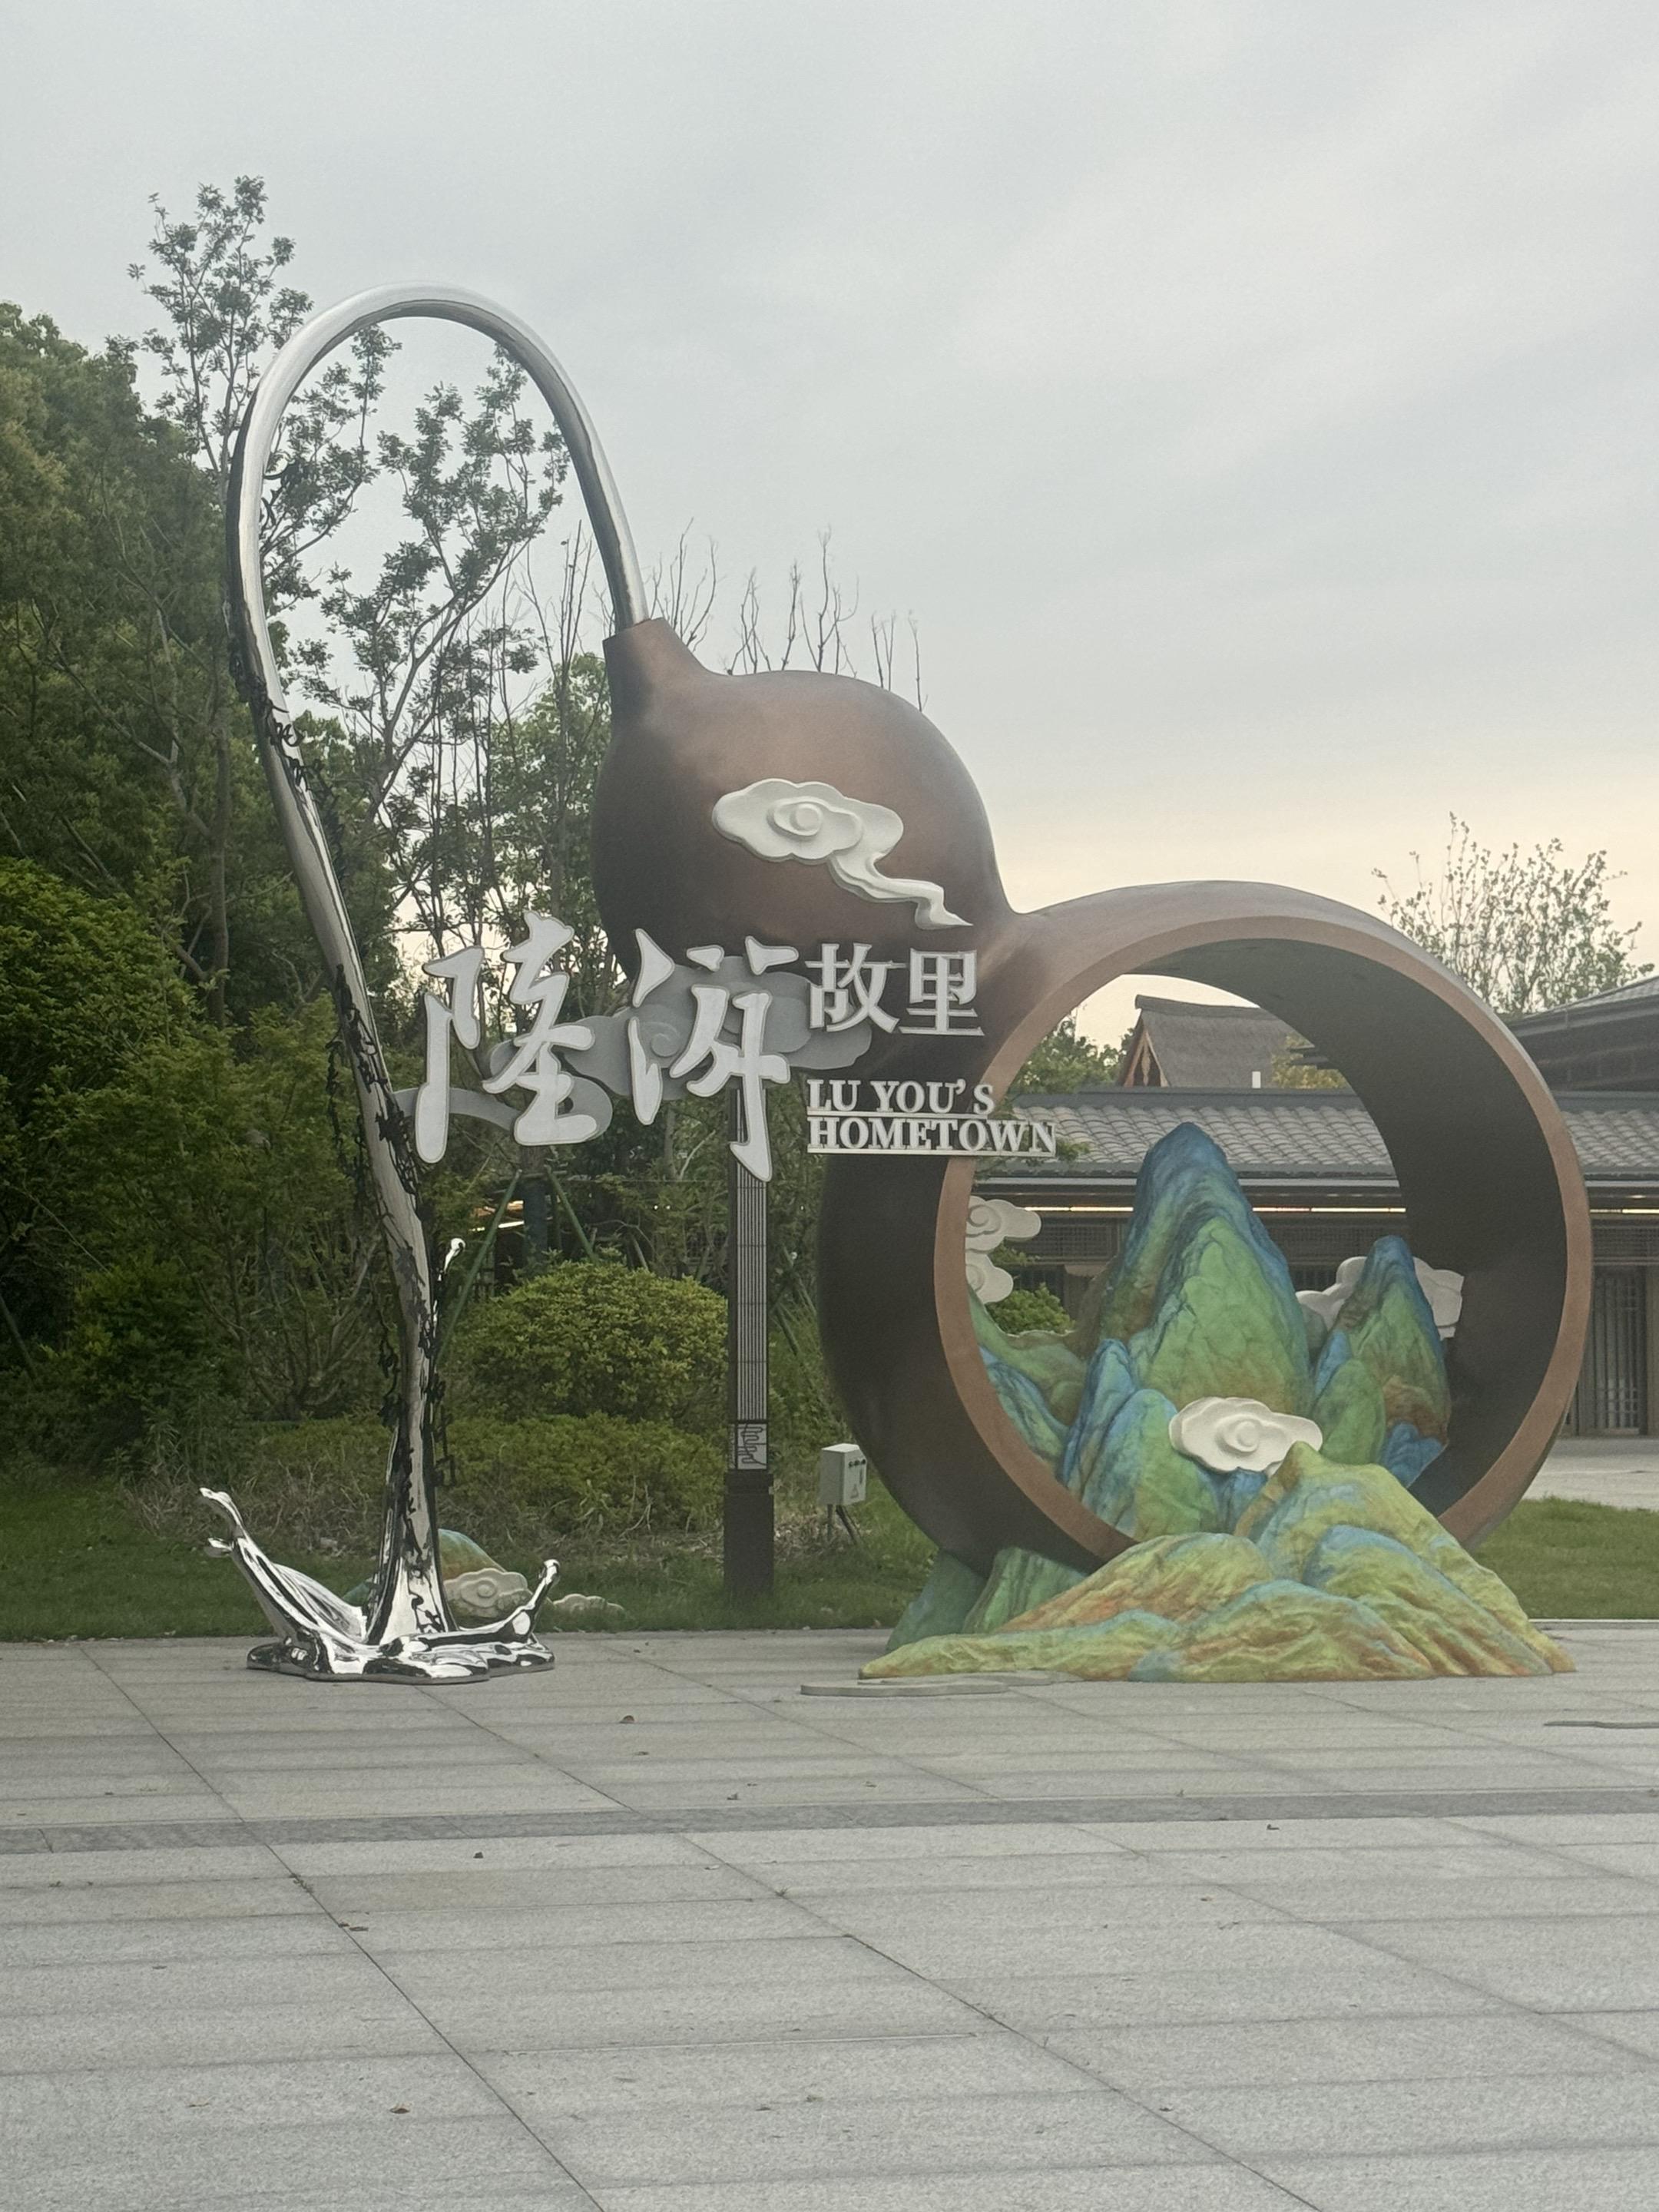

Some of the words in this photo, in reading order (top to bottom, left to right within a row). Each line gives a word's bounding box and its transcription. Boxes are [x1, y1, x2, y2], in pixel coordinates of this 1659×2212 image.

[804, 942, 985, 1036] 故里
[807, 1078, 861, 1112] LU
[870, 1078, 995, 1114] YOU'S
[807, 1116, 1057, 1154] HOMETOWN
